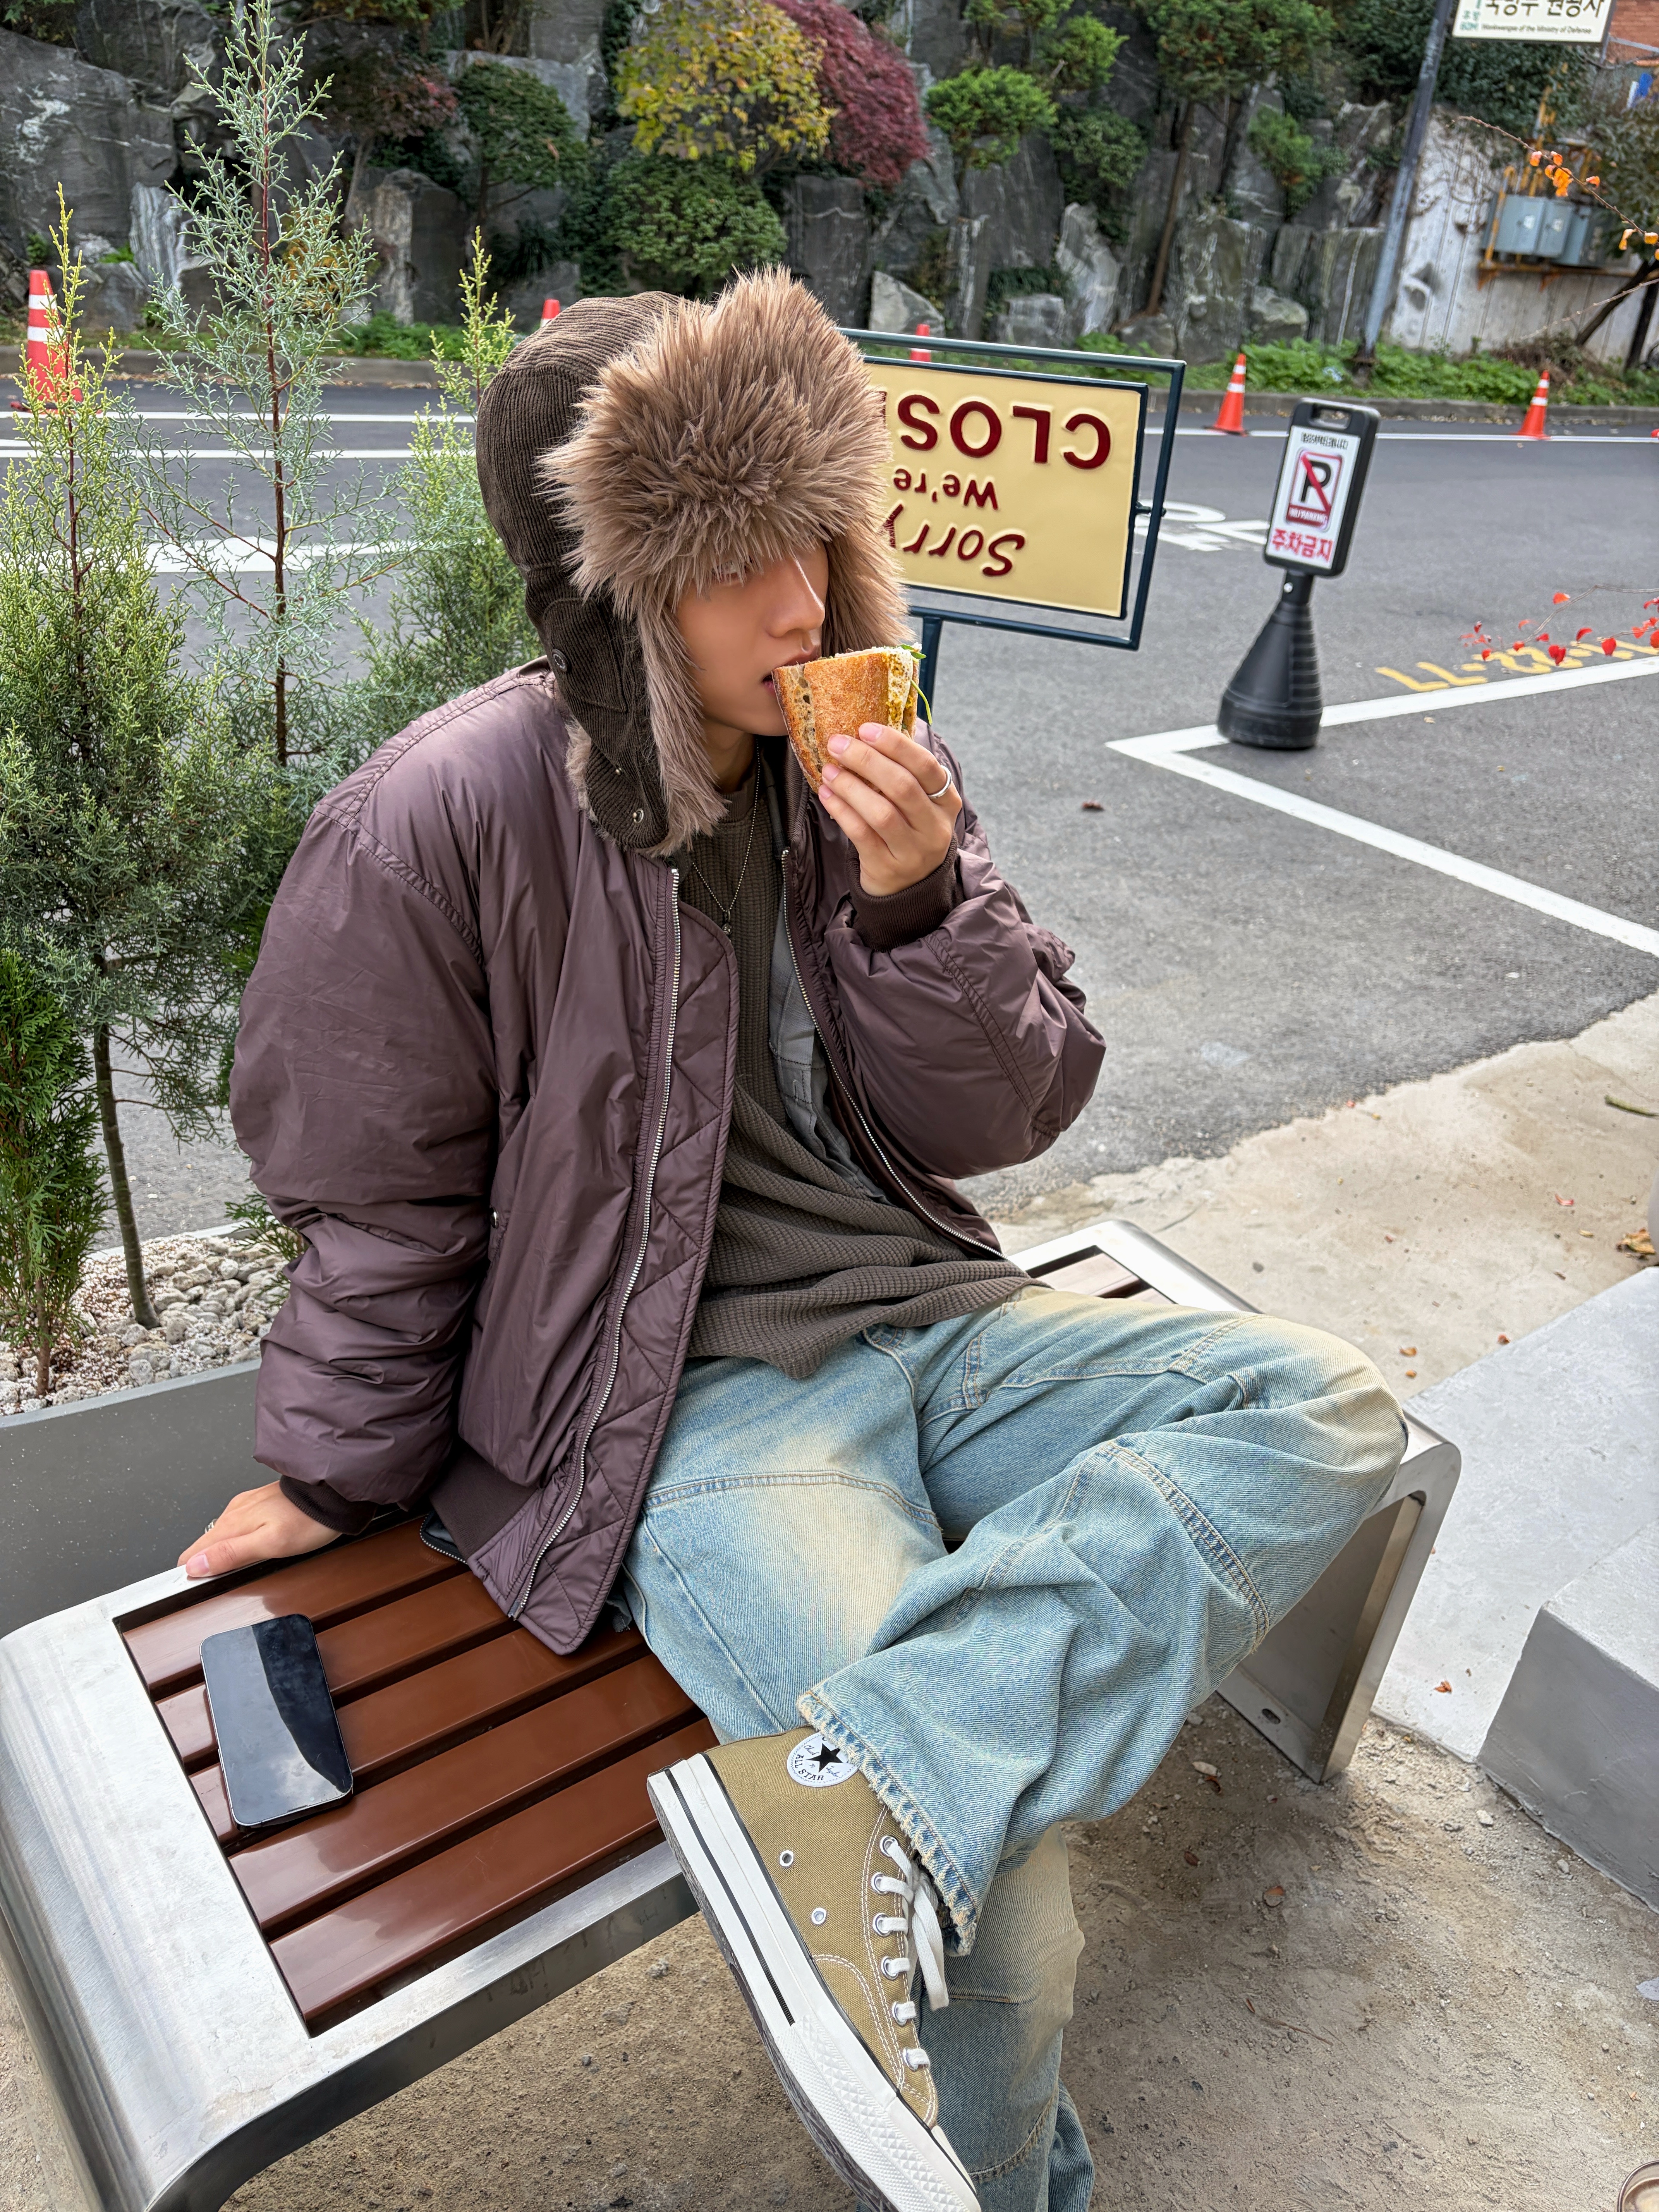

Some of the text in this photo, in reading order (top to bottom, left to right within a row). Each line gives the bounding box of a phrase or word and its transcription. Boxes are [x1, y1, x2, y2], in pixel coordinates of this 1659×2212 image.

[878, 391, 1111, 469] CLOS
[884, 504, 1025, 577] Sorry
[1273, 528, 1333, 562] 주차금지
[794, 1754, 824, 1781] ALL STAR
